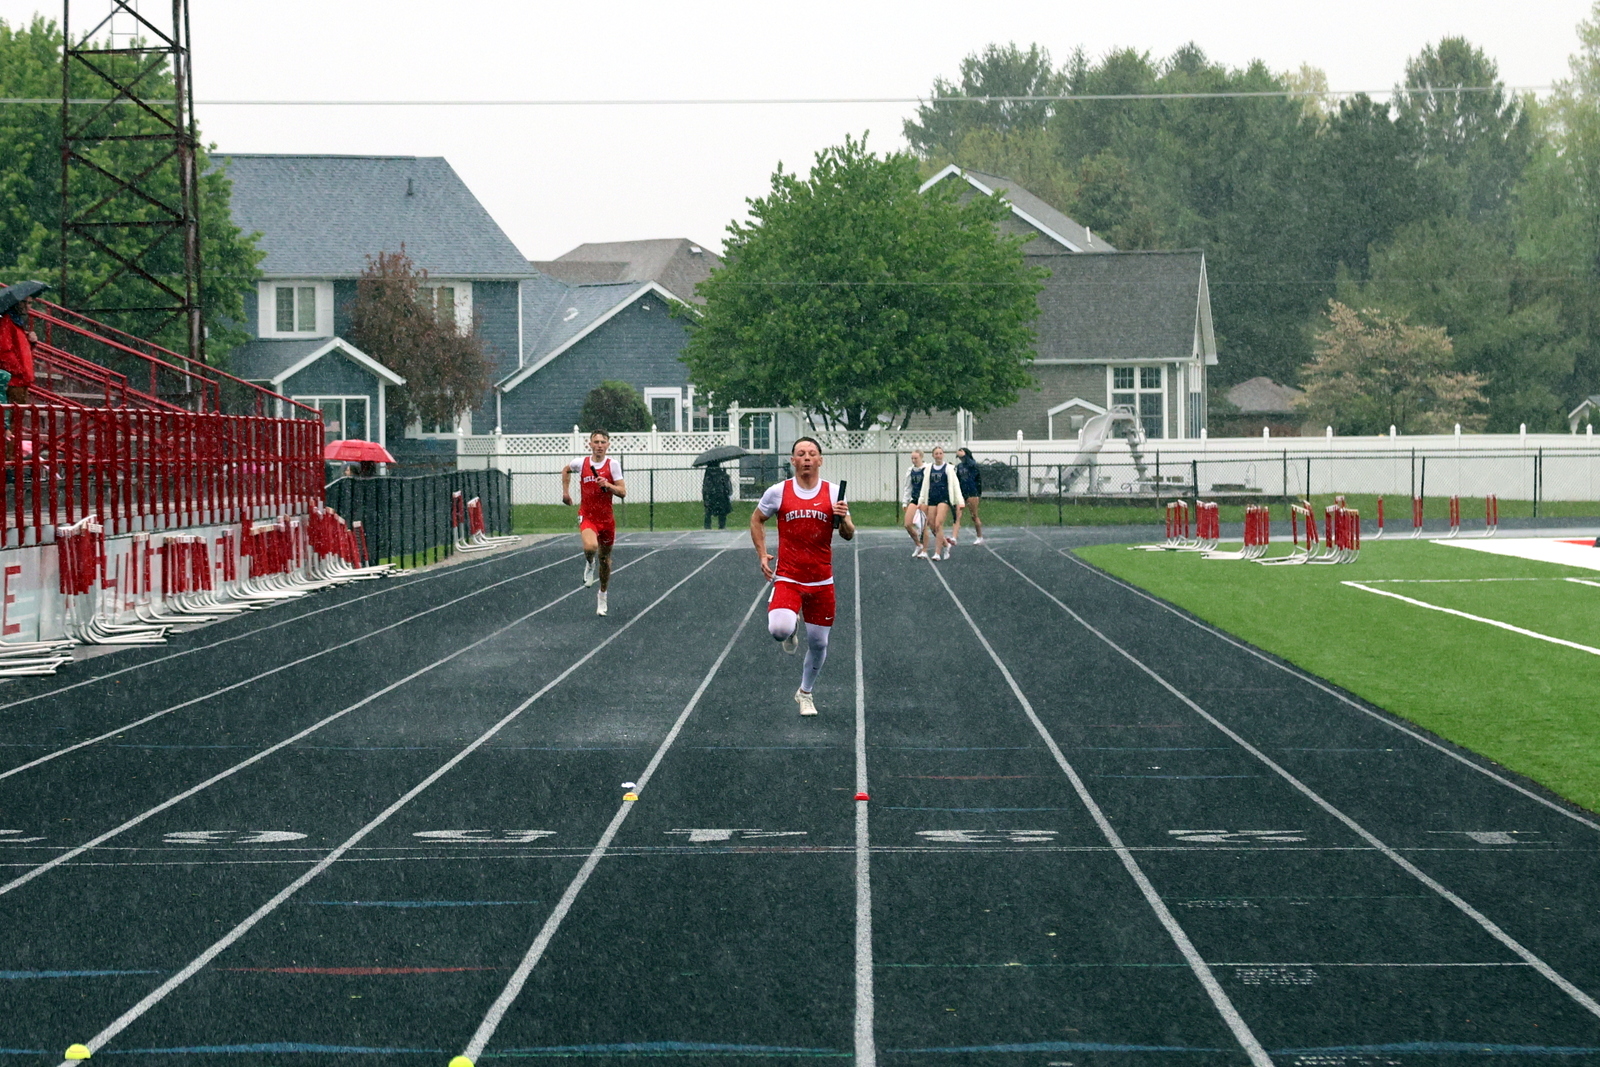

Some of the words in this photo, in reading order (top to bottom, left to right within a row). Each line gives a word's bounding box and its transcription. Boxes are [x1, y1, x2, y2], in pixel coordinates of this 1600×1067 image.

[785, 509, 829, 523] BELLEVUE
[412, 829, 557, 843] 5
[663, 828, 808, 842] 4
[914, 829, 1059, 843] 3
[1168, 829, 1308, 843] 2
